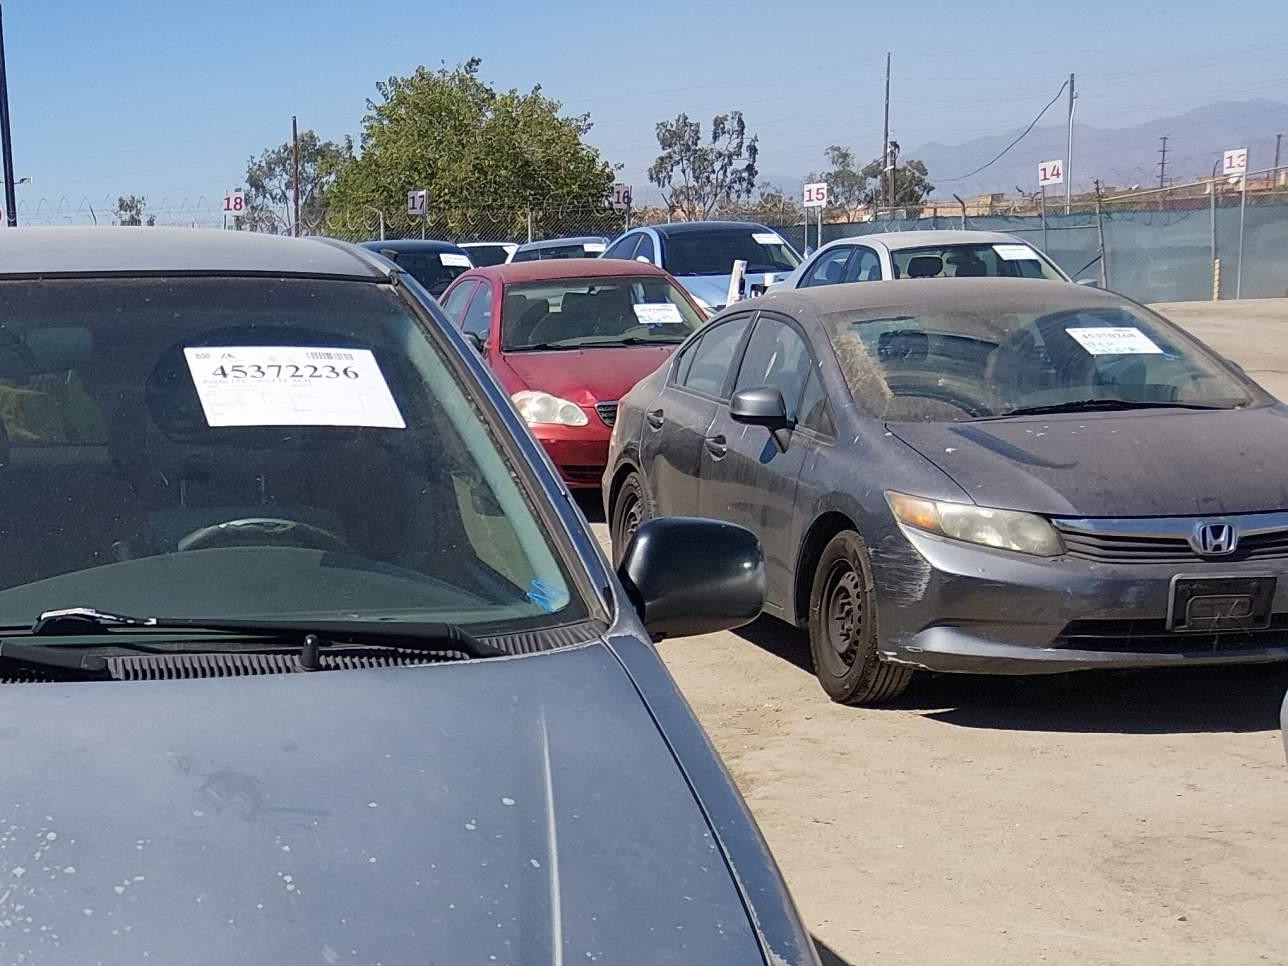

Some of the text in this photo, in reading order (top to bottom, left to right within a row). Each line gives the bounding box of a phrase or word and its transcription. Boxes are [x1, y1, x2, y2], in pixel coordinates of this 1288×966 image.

[1224, 153, 1246, 170] 13
[1039, 165, 1062, 181] 14
[409, 194, 425, 209] 17
[805, 187, 826, 202] 15
[223, 196, 243, 211] 18
[212, 364, 360, 380] 45372236
